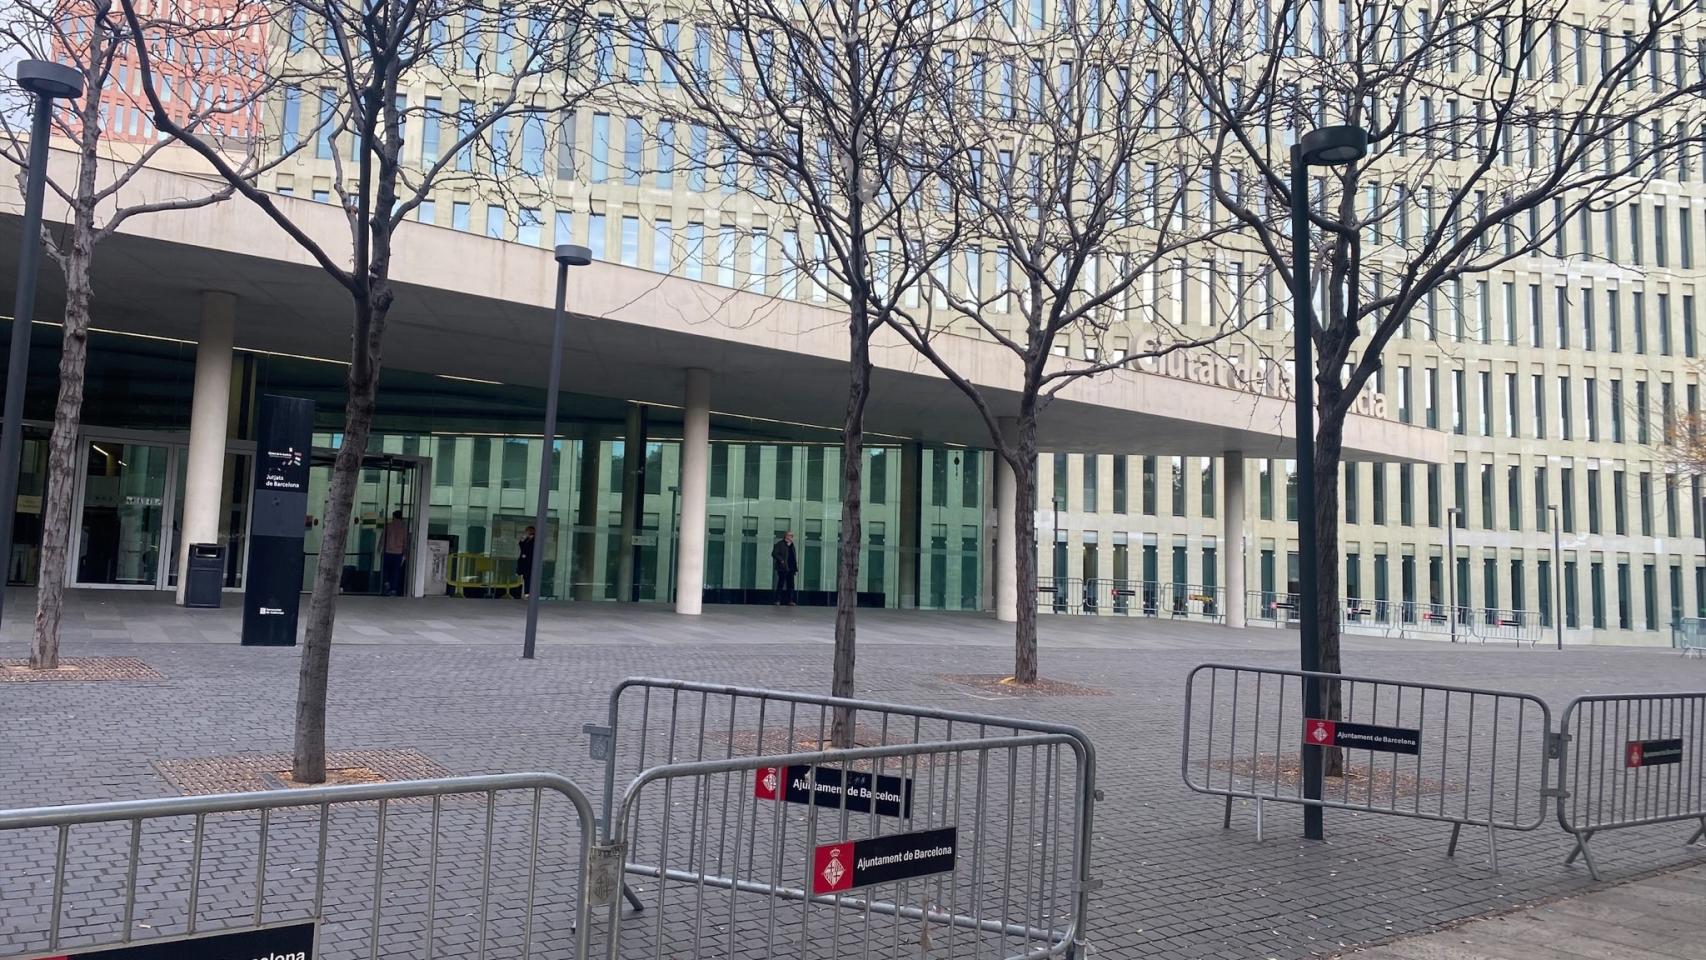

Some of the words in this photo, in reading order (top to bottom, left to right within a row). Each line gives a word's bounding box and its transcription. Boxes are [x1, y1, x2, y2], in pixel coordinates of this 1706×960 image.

[1337, 731, 1374, 741] Ajuntament
[1383, 736, 1416, 746] Barcelona
[793, 779, 843, 794] Ajutamen
[847, 786, 859, 797] de
[860, 787, 901, 802] Bacelon
[857, 852, 902, 871] Ajuntament
[903, 850, 913, 861] de
[914, 846, 952, 860] Barcelona
